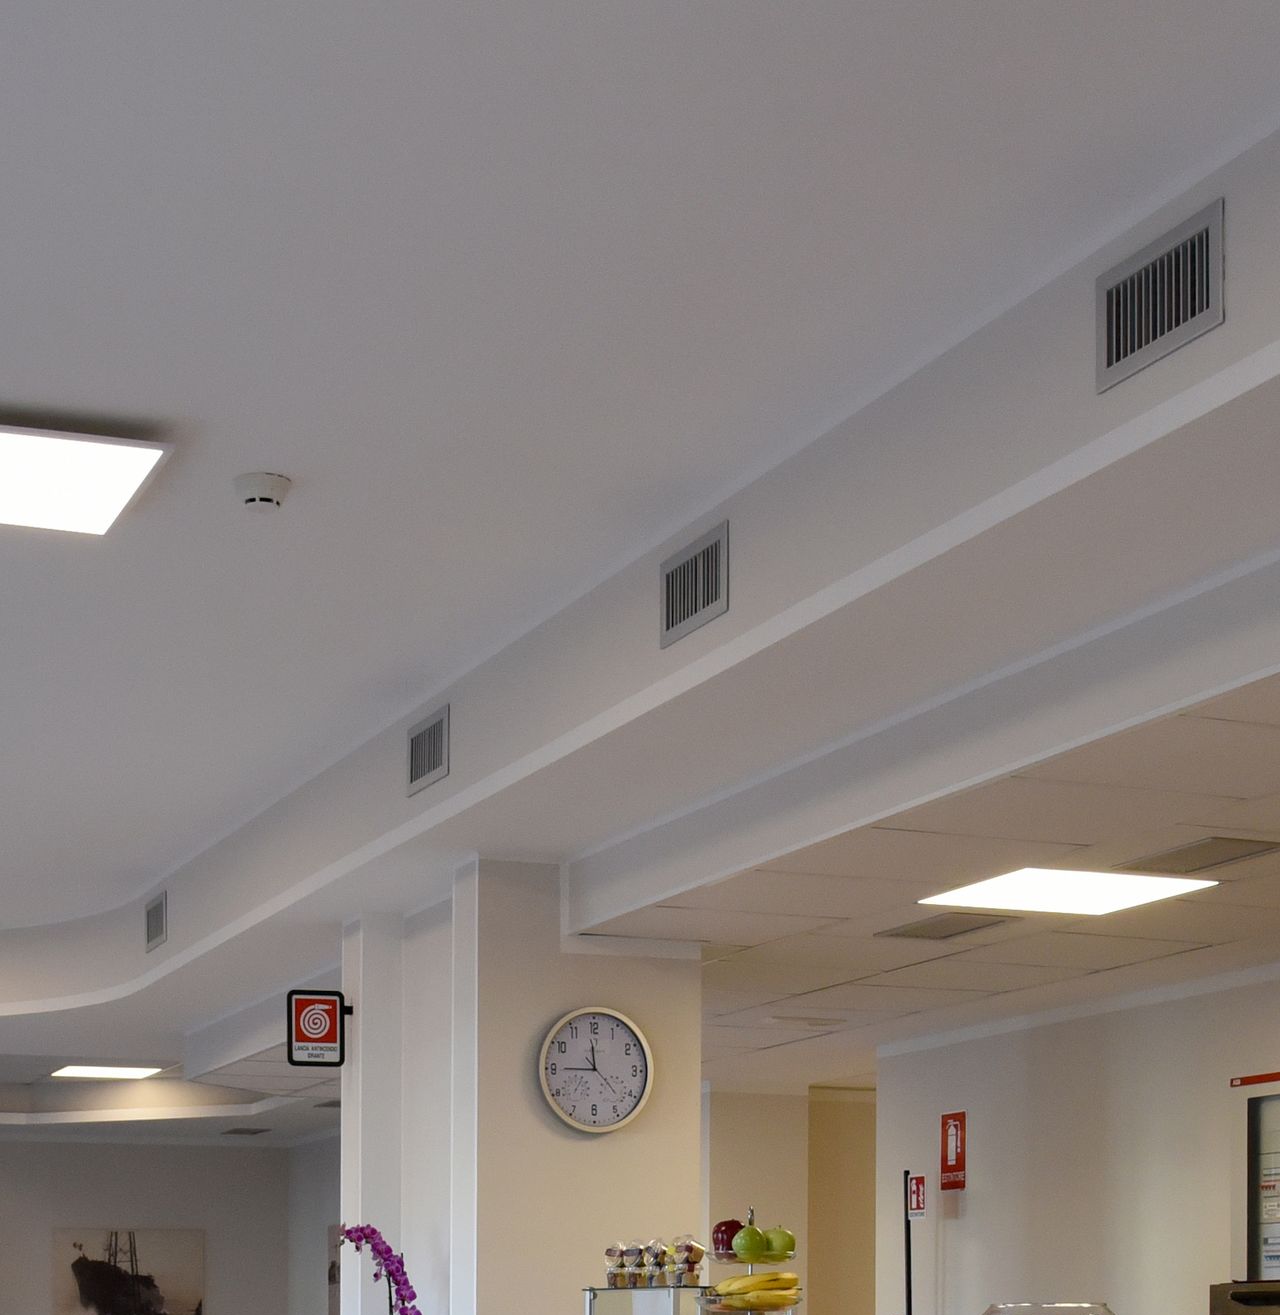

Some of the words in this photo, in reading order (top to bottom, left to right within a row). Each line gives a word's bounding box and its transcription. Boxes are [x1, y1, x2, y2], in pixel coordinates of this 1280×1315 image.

[570, 1026, 578, 1039] 11
[589, 1022, 599, 1035] 12
[610, 1027, 614, 1040] 1
[556, 1041, 567, 1054] 10
[624, 1043, 631, 1056] 2
[550, 1062, 557, 1075] 9
[631, 1064, 638, 1077] 3
[555, 1088, 560, 1097] 8
[627, 1089, 633, 1098] 4
[571, 1104, 576, 1113] 7
[591, 1104, 598, 1116] 6
[612, 1105, 618, 1114] 5
